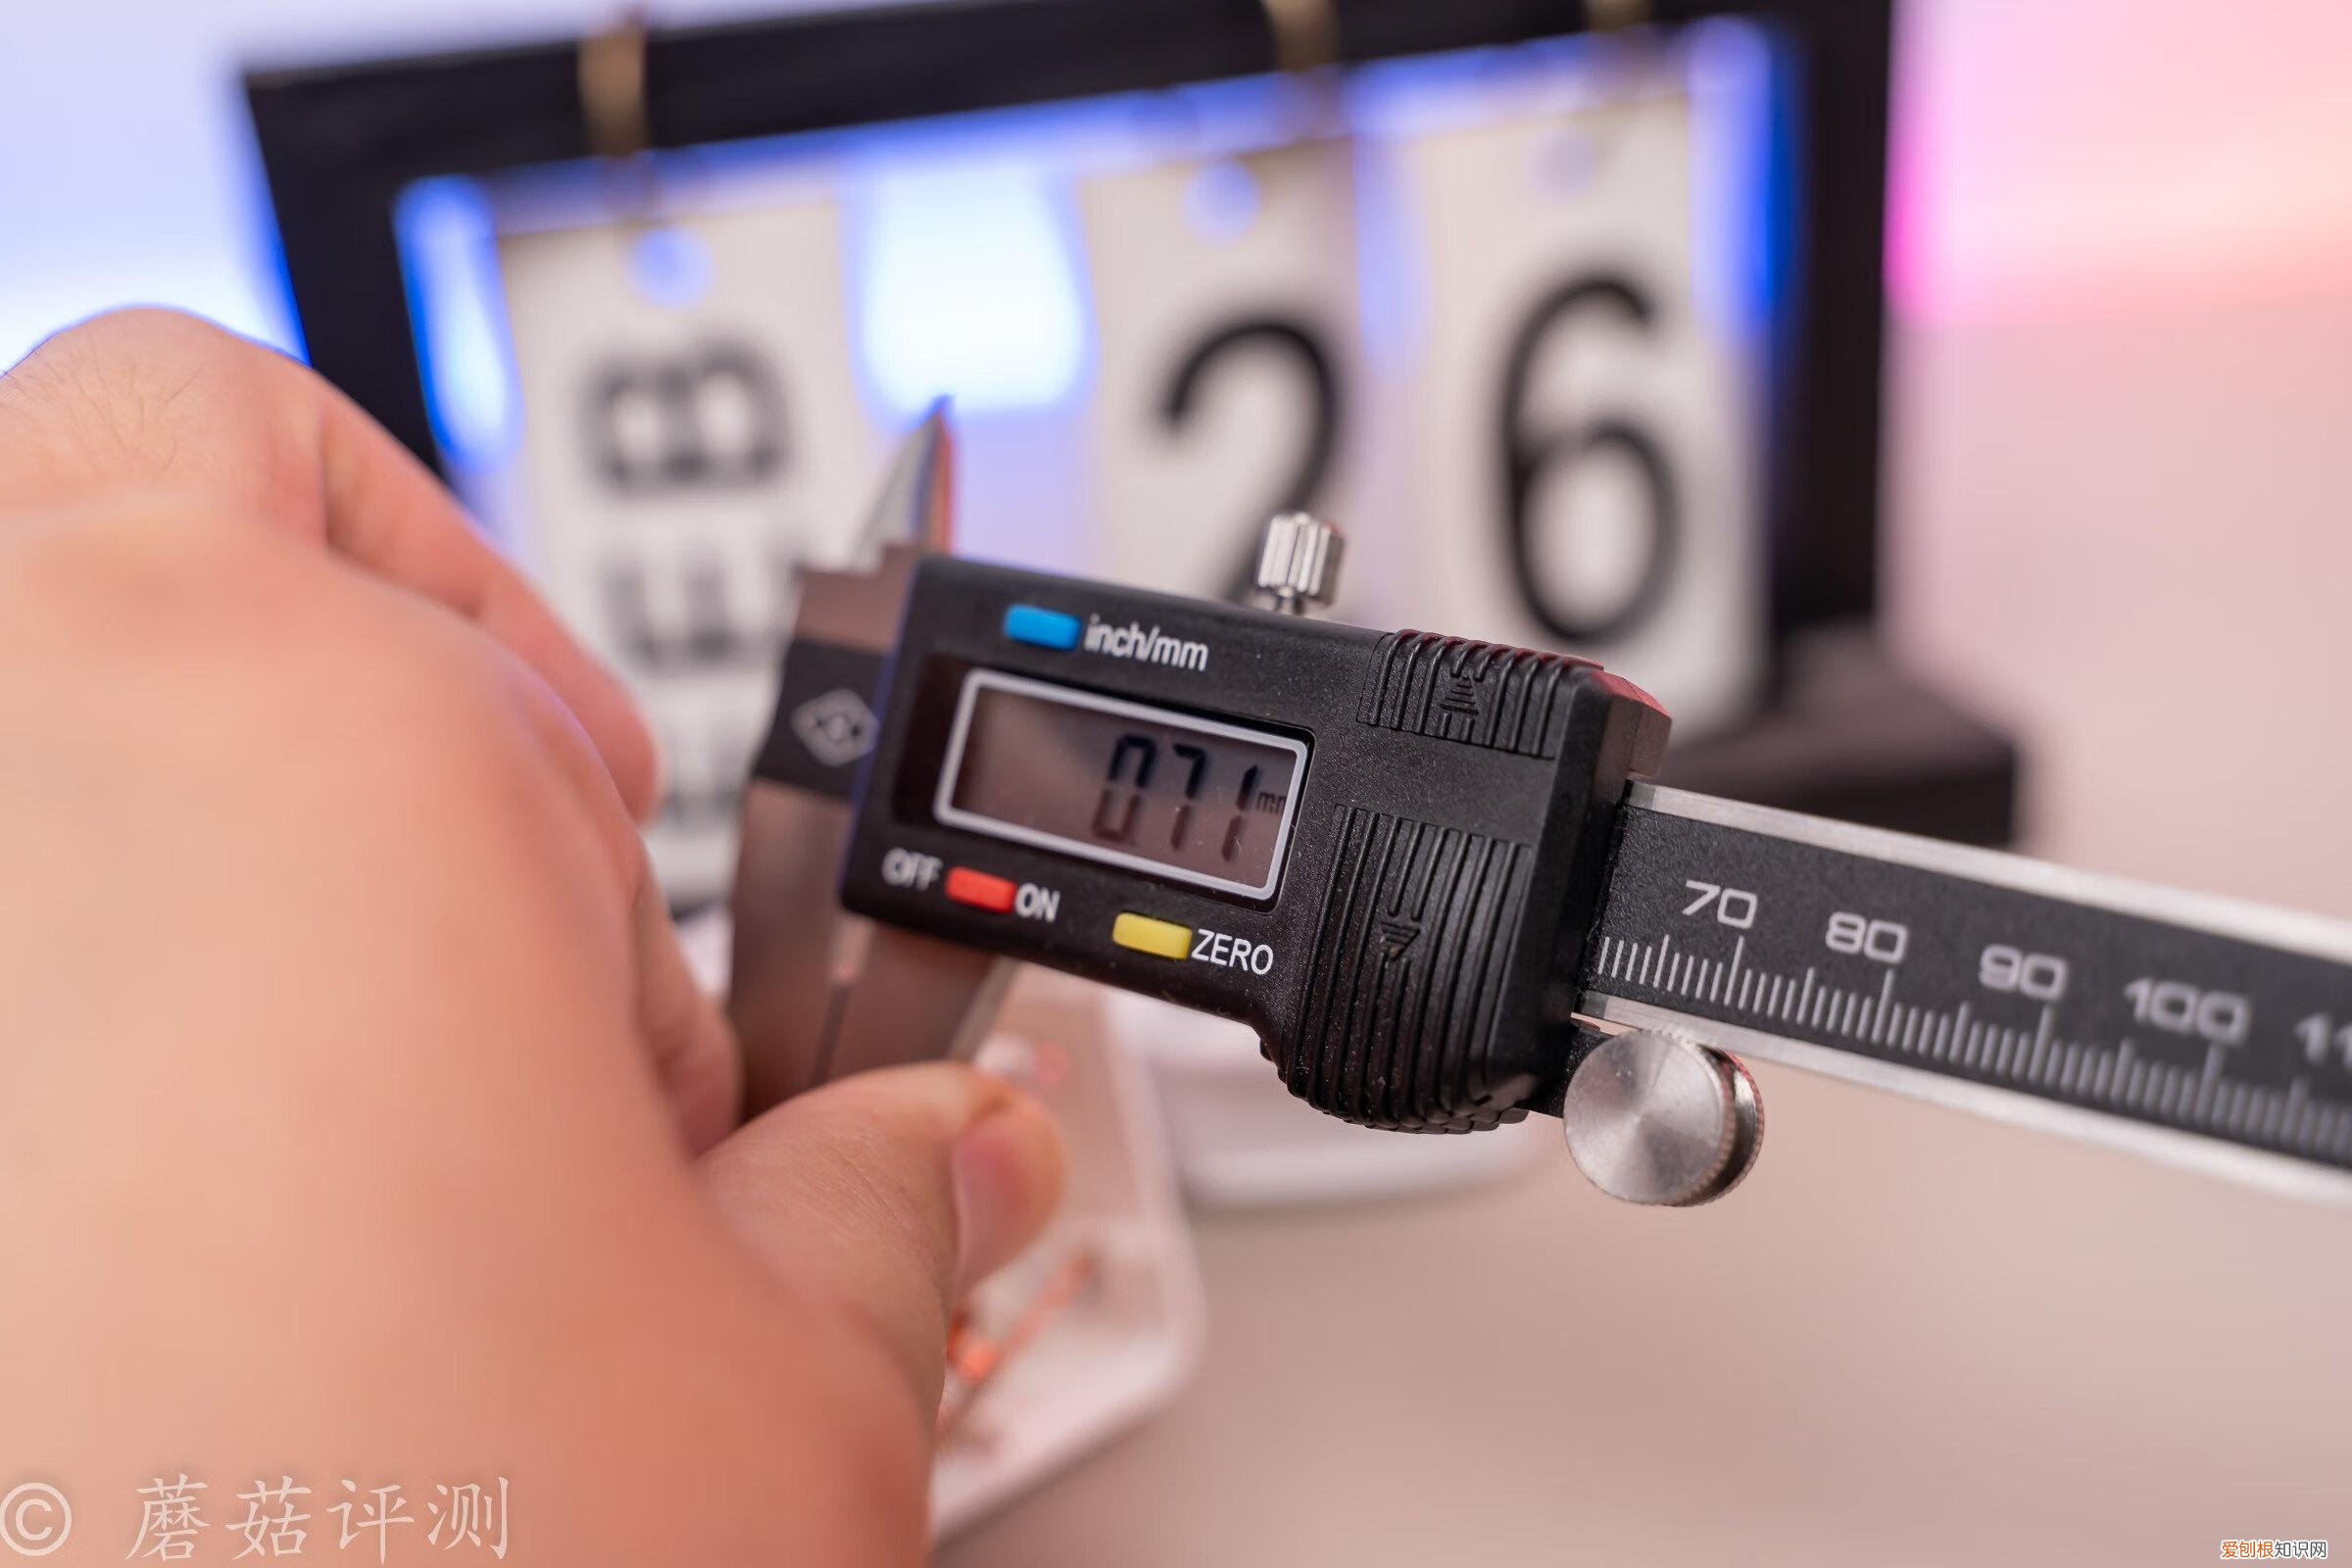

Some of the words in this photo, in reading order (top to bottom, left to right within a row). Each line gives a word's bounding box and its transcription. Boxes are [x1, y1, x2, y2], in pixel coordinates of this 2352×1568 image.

[1502, 274, 1681, 645] 6
[1085, 614, 1209, 672] inch/mm
[882, 847, 944, 891] OFF
[1015, 884, 1061, 923] ON
[1192, 929, 1275, 976] ZERO
[1681, 879, 1758, 930] 70
[1825, 911, 1908, 964] 80
[1979, 944, 2067, 1001] 90
[2123, 976, 2250, 1047] 100
